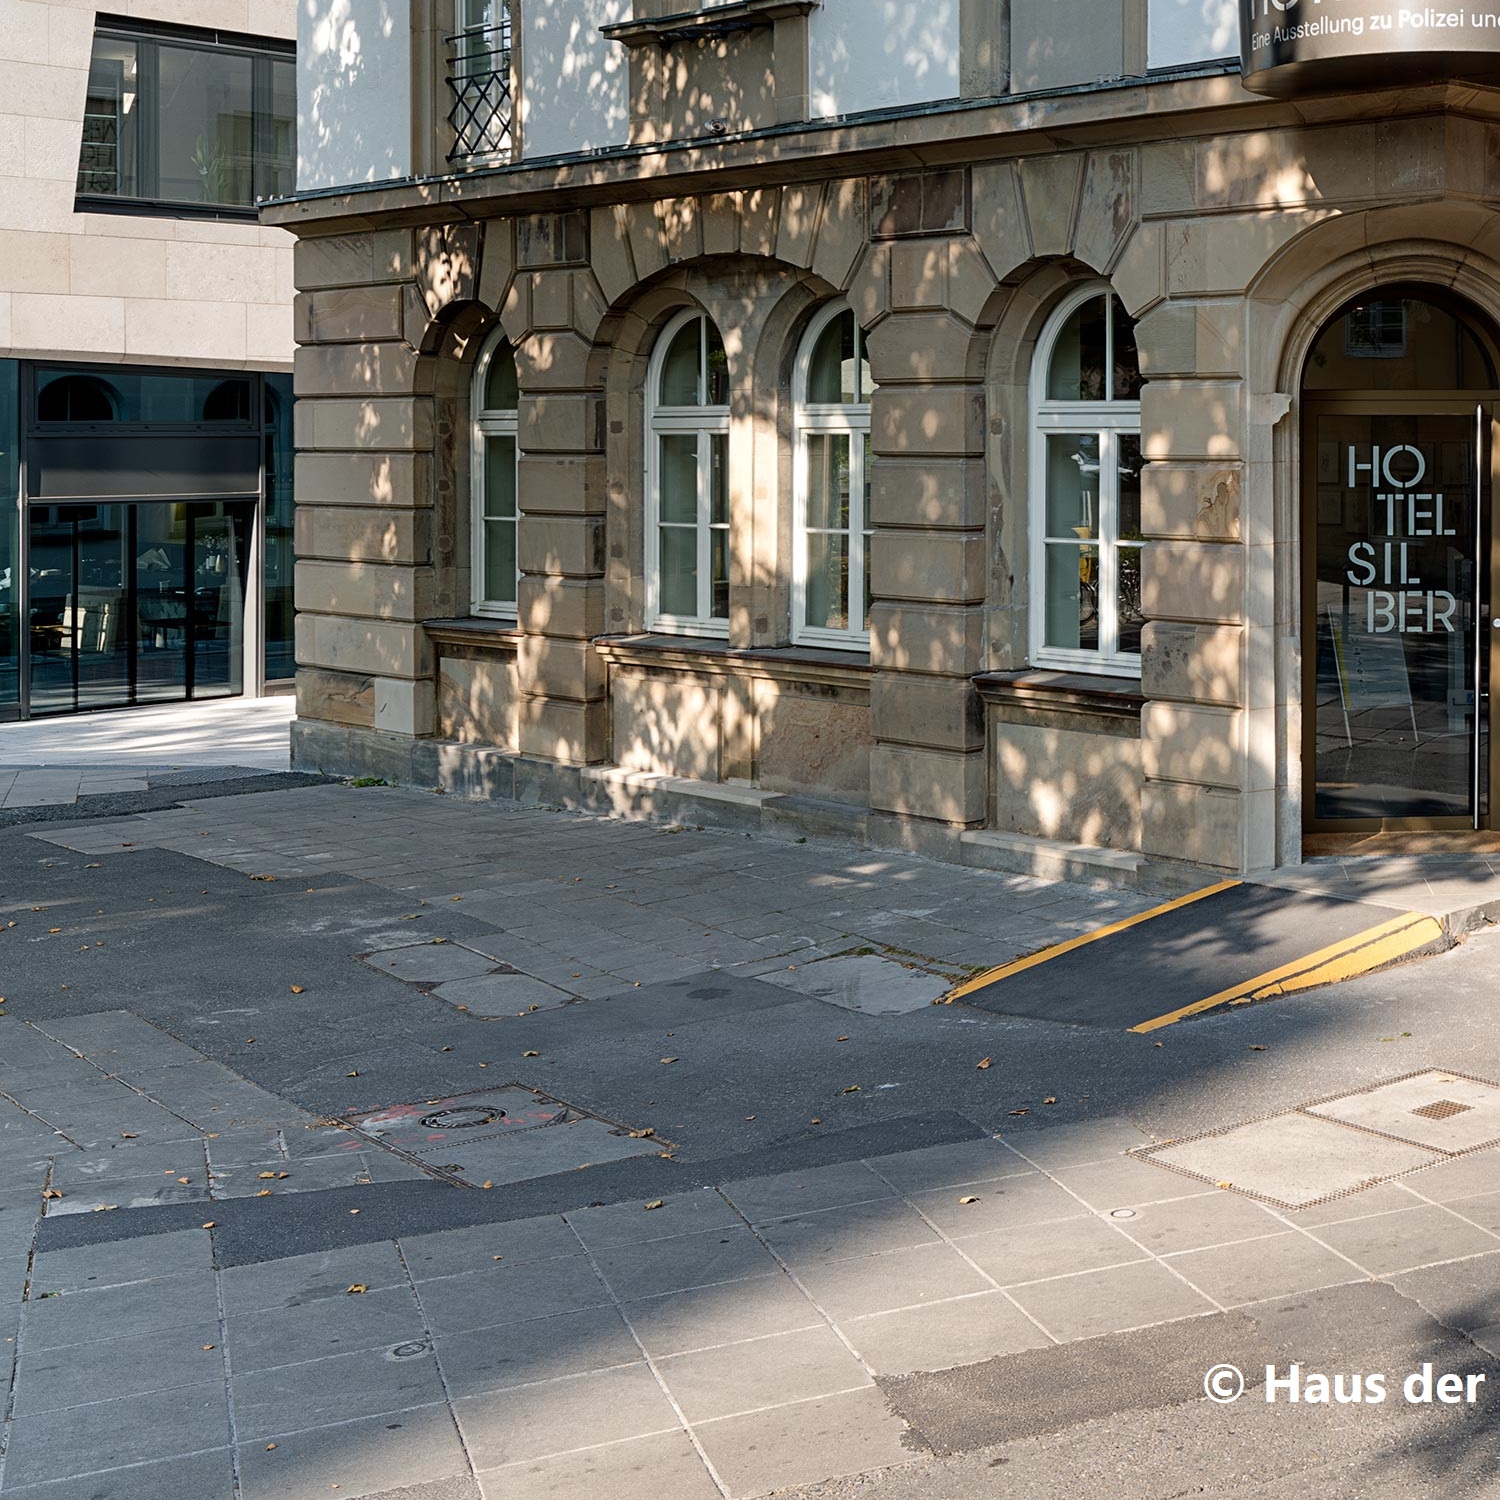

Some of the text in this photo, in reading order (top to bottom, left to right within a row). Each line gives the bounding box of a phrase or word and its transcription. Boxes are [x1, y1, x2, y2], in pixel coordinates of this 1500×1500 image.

[1252, 32, 1271, 51] Eine
[1273, 15, 1364, 43] Ausstellung
[1369, 14, 1392, 31] zu
[1398, 7, 1464, 30] Polizei
[1348, 444, 1426, 489] HO
[1376, 493, 1456, 536] TEL
[1347, 541, 1420, 586] SIL
[1367, 590, 1456, 633] BER
